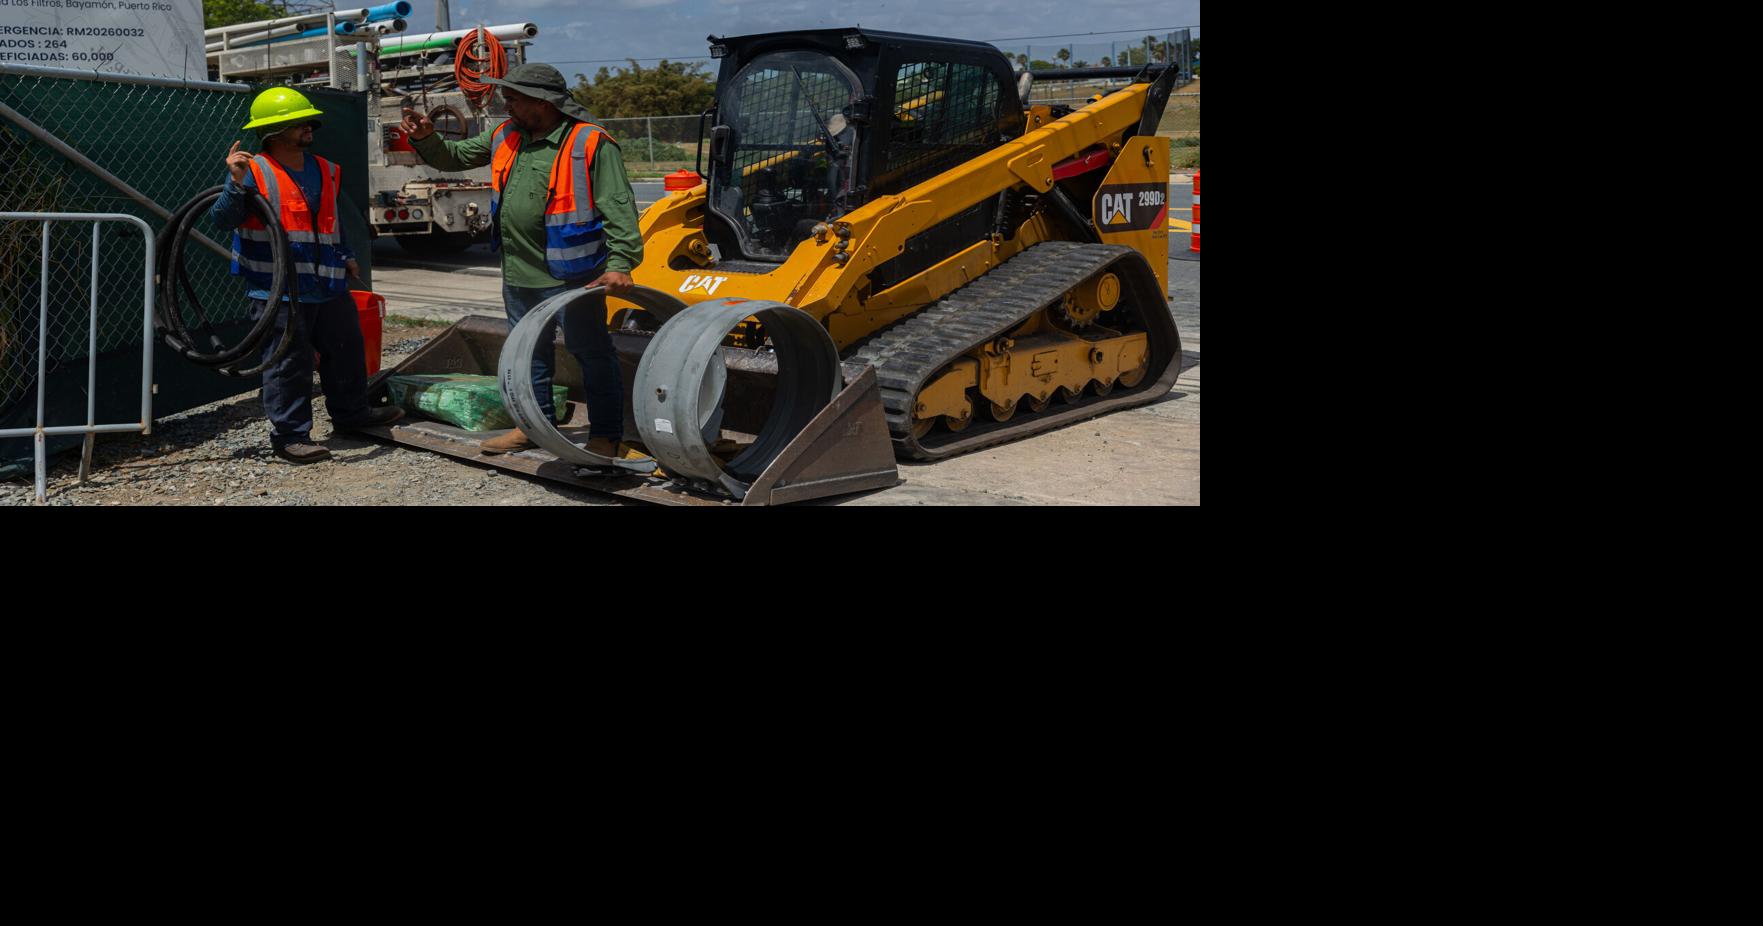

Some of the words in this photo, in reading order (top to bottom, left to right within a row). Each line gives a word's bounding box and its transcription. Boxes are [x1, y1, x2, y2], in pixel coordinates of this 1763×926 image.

[65, 0, 117, 11] Bayamón,
[119, 2, 150, 10] Puerto
[152, 3, 172, 11] Rico
[66, 27, 145, 37] RM20260032
[44, 40, 68, 49] 264
[71, 52, 114, 62] 60,000
[1101, 192, 1134, 225] CAT
[1138, 190, 1166, 207] 299D2
[678, 274, 729, 296] CAT
